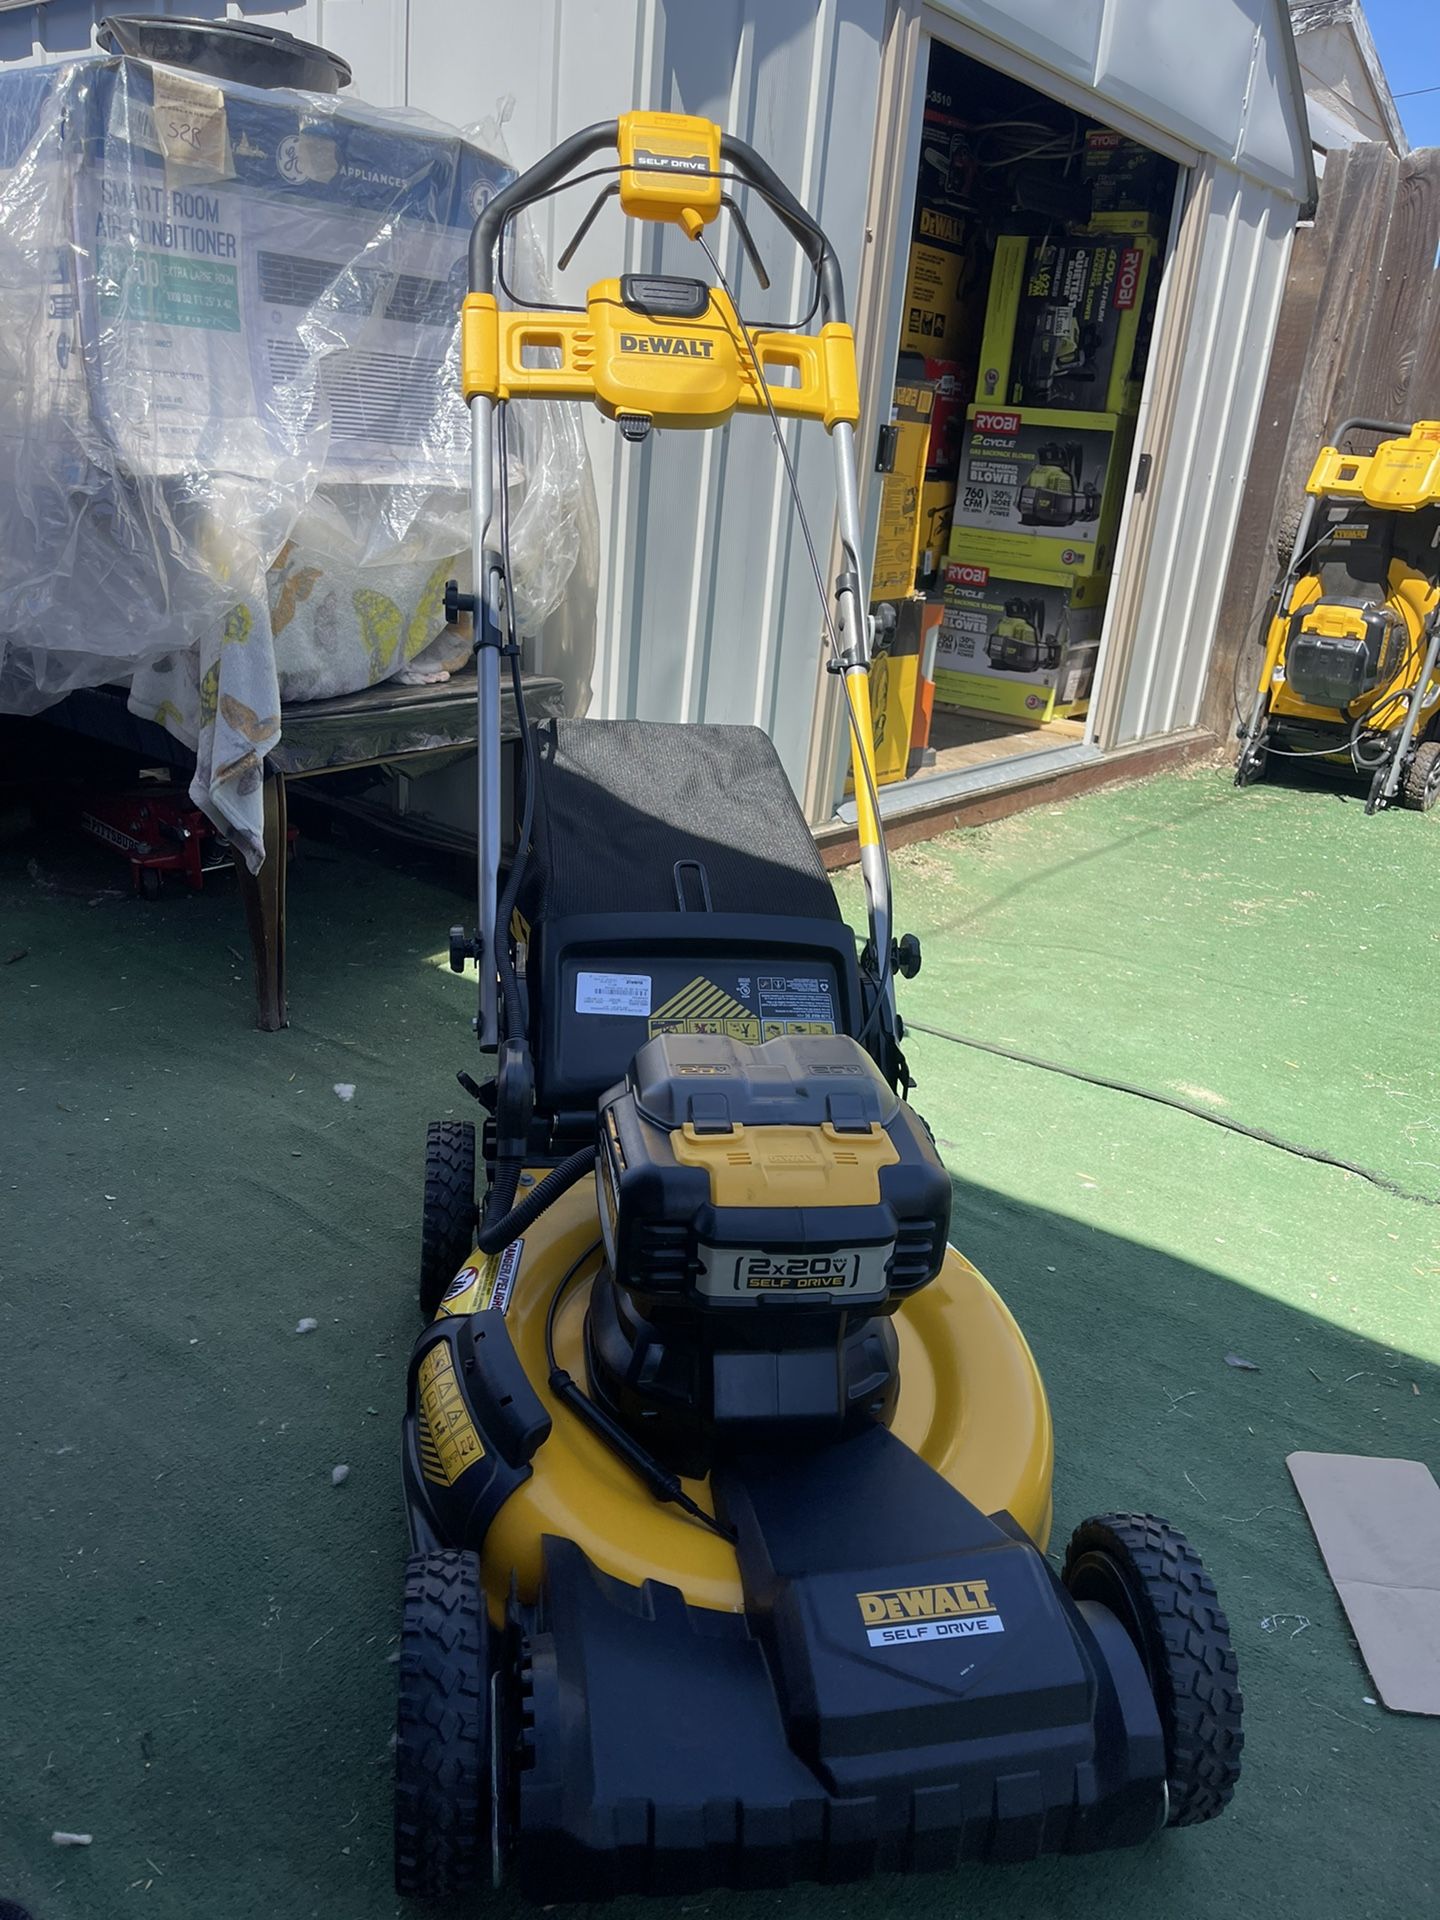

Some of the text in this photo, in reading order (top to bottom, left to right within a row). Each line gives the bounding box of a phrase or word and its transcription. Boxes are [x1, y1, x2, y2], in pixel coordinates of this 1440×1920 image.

[638, 156, 706, 171] SELF DRIVE
[339, 165, 408, 191] APPLIANCES
[101, 179, 220, 224] SMART ROOM
[130, 216, 237, 259] CONDITIONER
[1068, 250, 1085, 309] QUIETEST
[1117, 251, 1140, 305] RYOBI
[1084, 288, 1095, 320] BLOWER
[619, 333, 714, 359] DEWALT
[976, 414, 1018, 431] RYOBI
[970, 471, 1018, 485] BLOWER
[963, 498, 982, 508] CFM
[965, 487, 984, 498] 760
[948, 567, 986, 583] RYOBI
[749, 1277, 844, 1288] SELF DRIVE
[857, 1582, 990, 1622] DEWALT
[883, 1620, 990, 1641] SELF DRIVE
